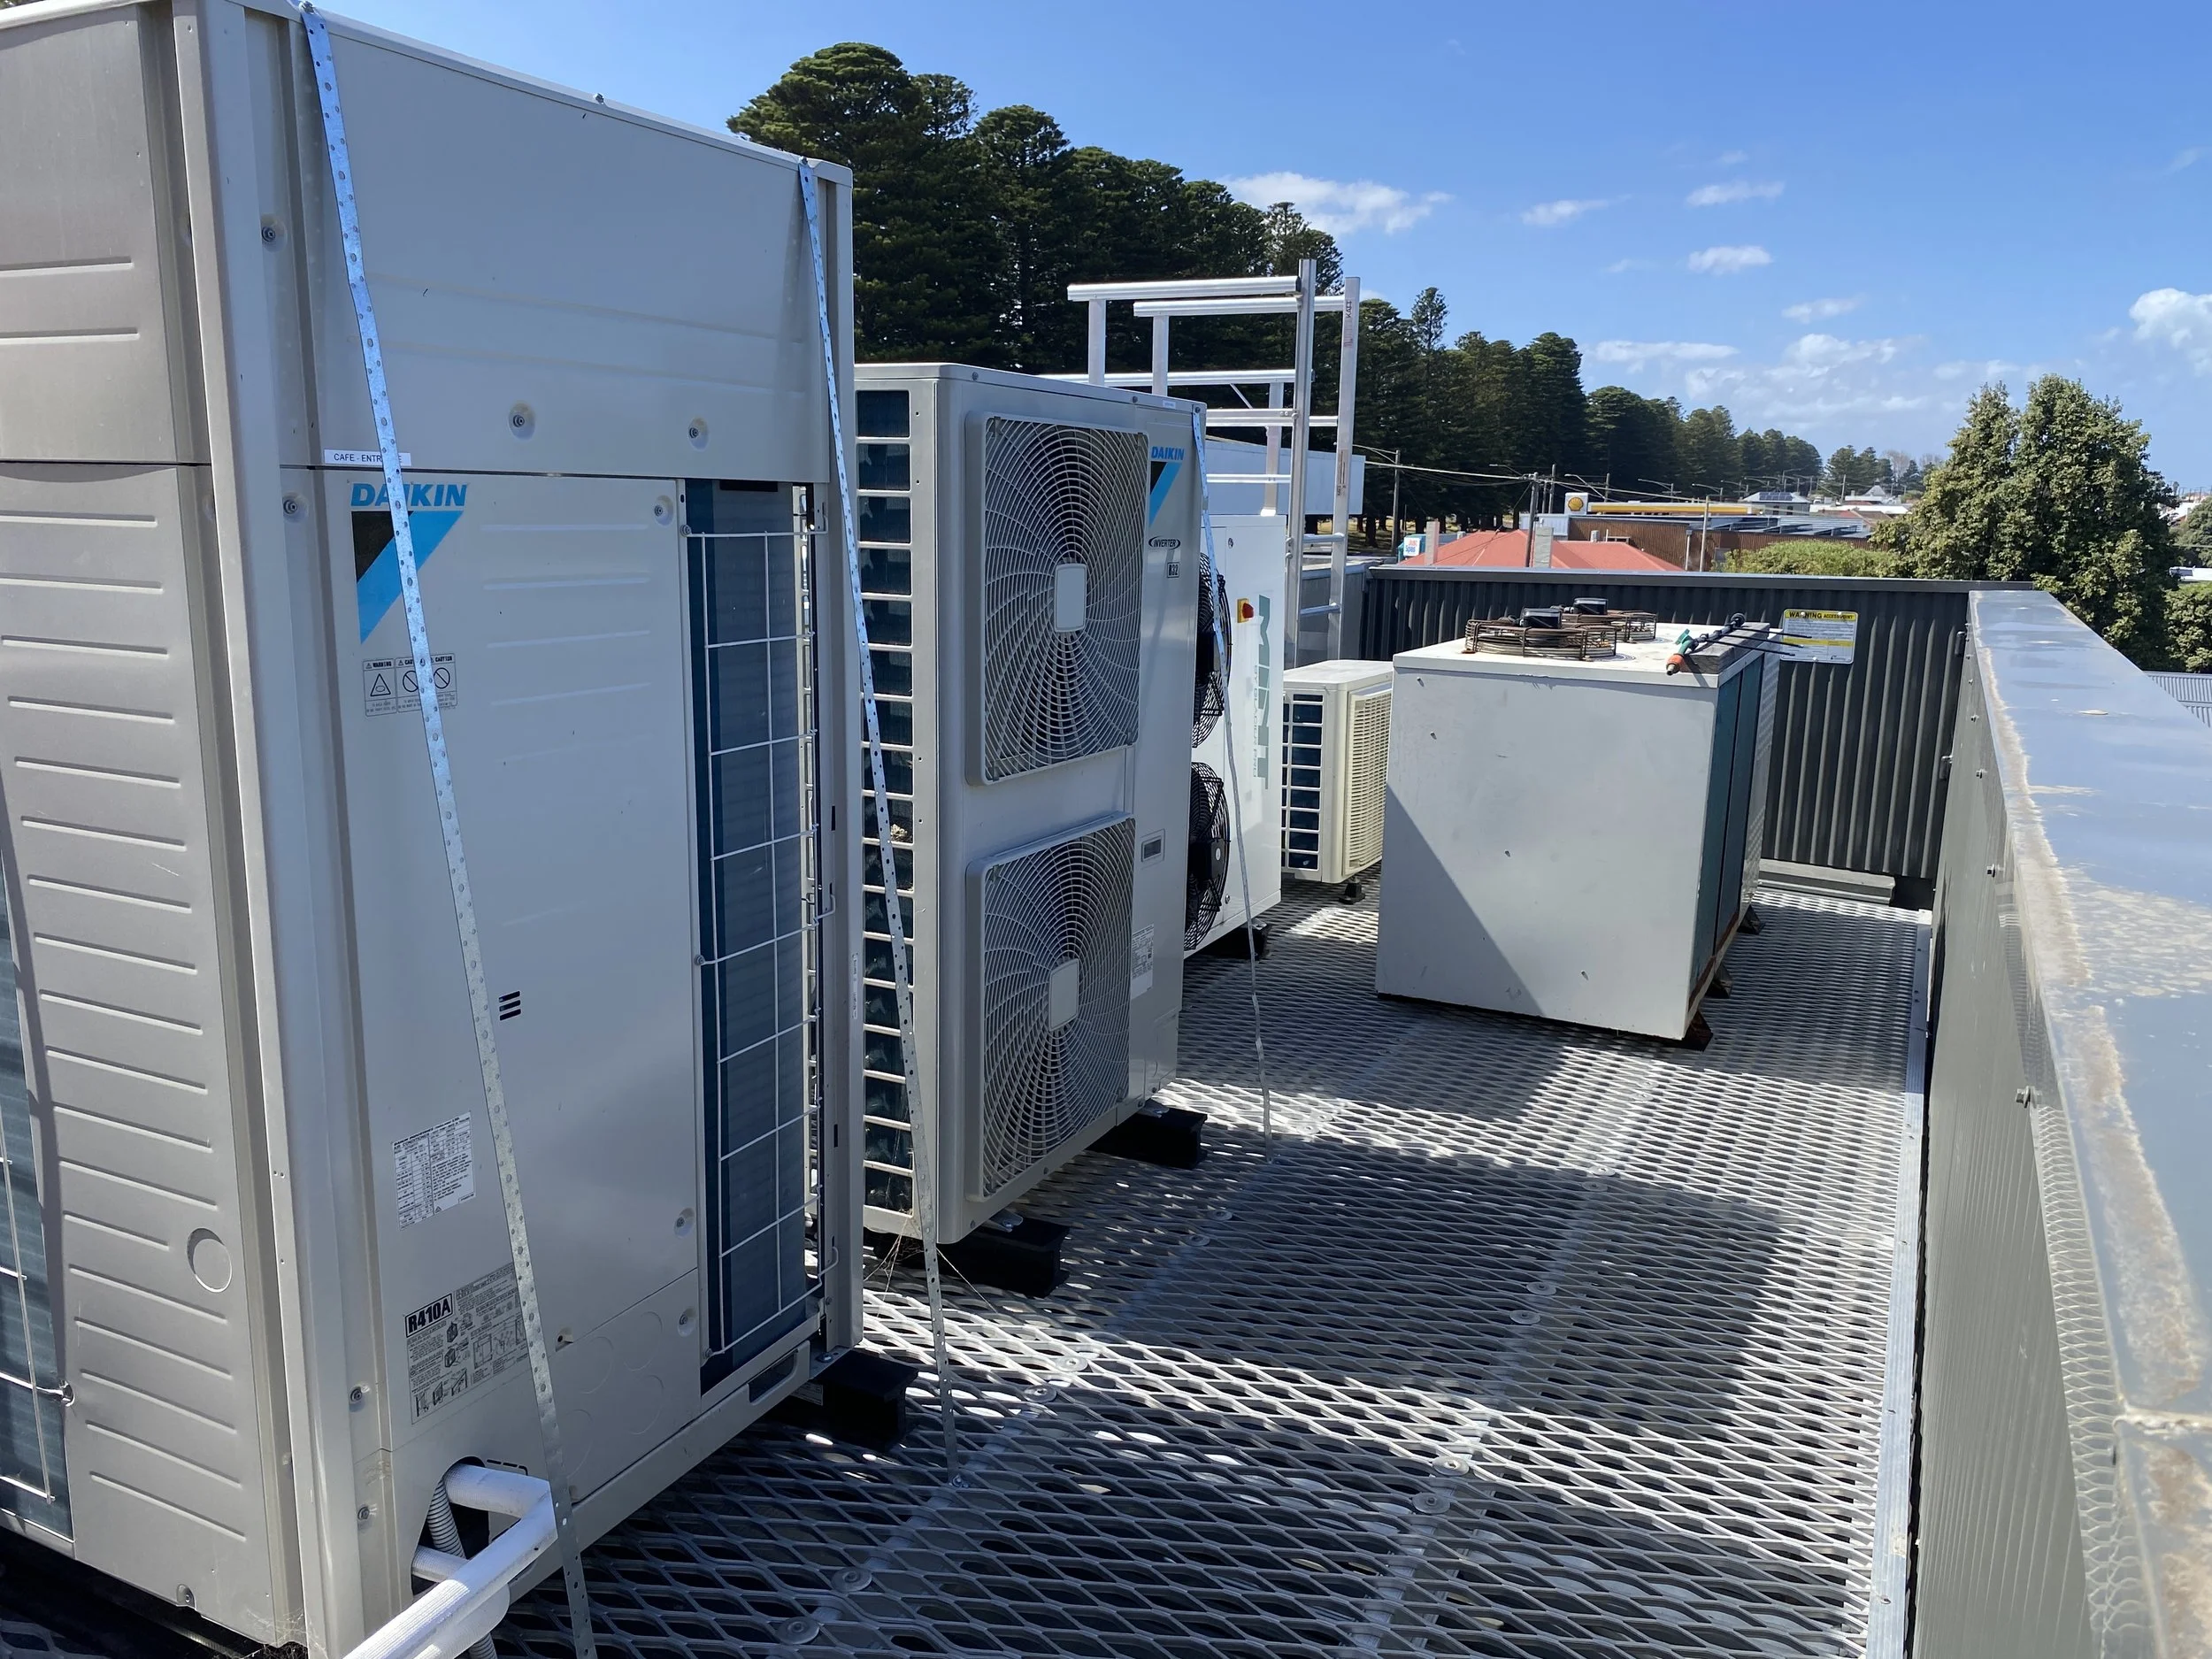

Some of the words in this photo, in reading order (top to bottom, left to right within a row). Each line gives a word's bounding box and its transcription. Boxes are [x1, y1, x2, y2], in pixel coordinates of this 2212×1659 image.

[334, 453, 355, 462] CAFE
[361, 454, 403, 464] ENTRE
[1151, 446, 1185, 461] DAIKIN
[1153, 539, 1177, 548] INVERTER
[408, 1297, 451, 1333] R410A
